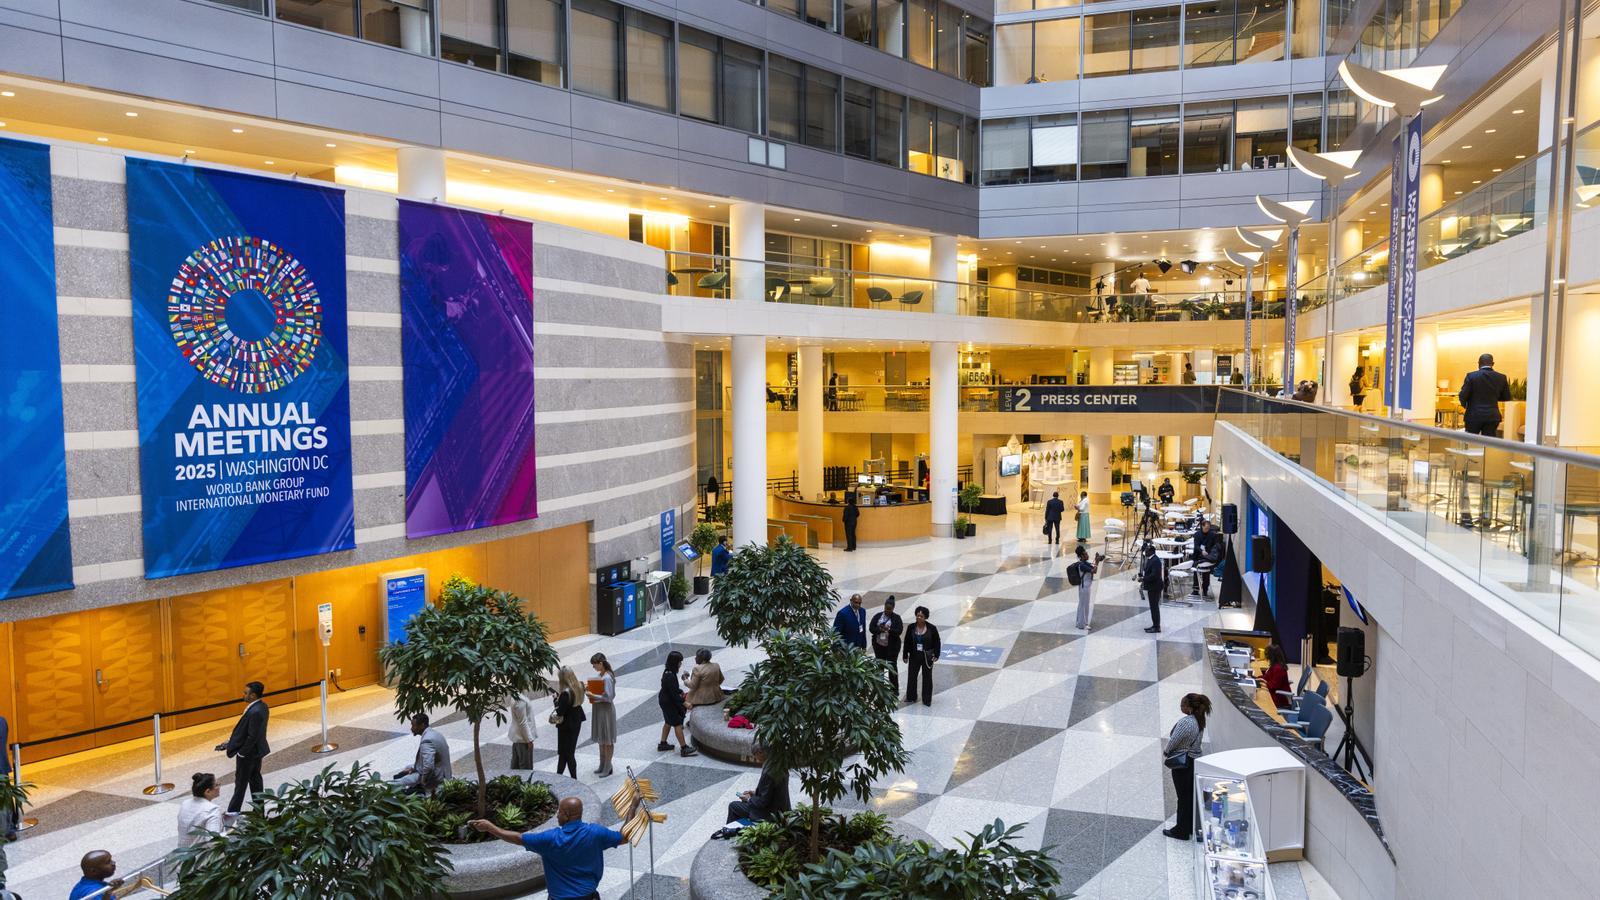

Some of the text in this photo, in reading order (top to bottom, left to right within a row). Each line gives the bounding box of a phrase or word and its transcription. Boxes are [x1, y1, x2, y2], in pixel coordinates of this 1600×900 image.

[1404, 193, 1412, 313] MONETARY
[1004, 388, 1031, 411] LEVEL 2
[1041, 394, 1137, 405] PRESS CENTER
[188, 402, 316, 430] ANNUAL
[174, 426, 328, 458] MEETINGS
[175, 455, 329, 481] 2025 WASHINGTON DC
[206, 477, 305, 496] WORLD BANK GROUP
[176, 487, 330, 512] INTERNATIONAL MONETARY FUND
